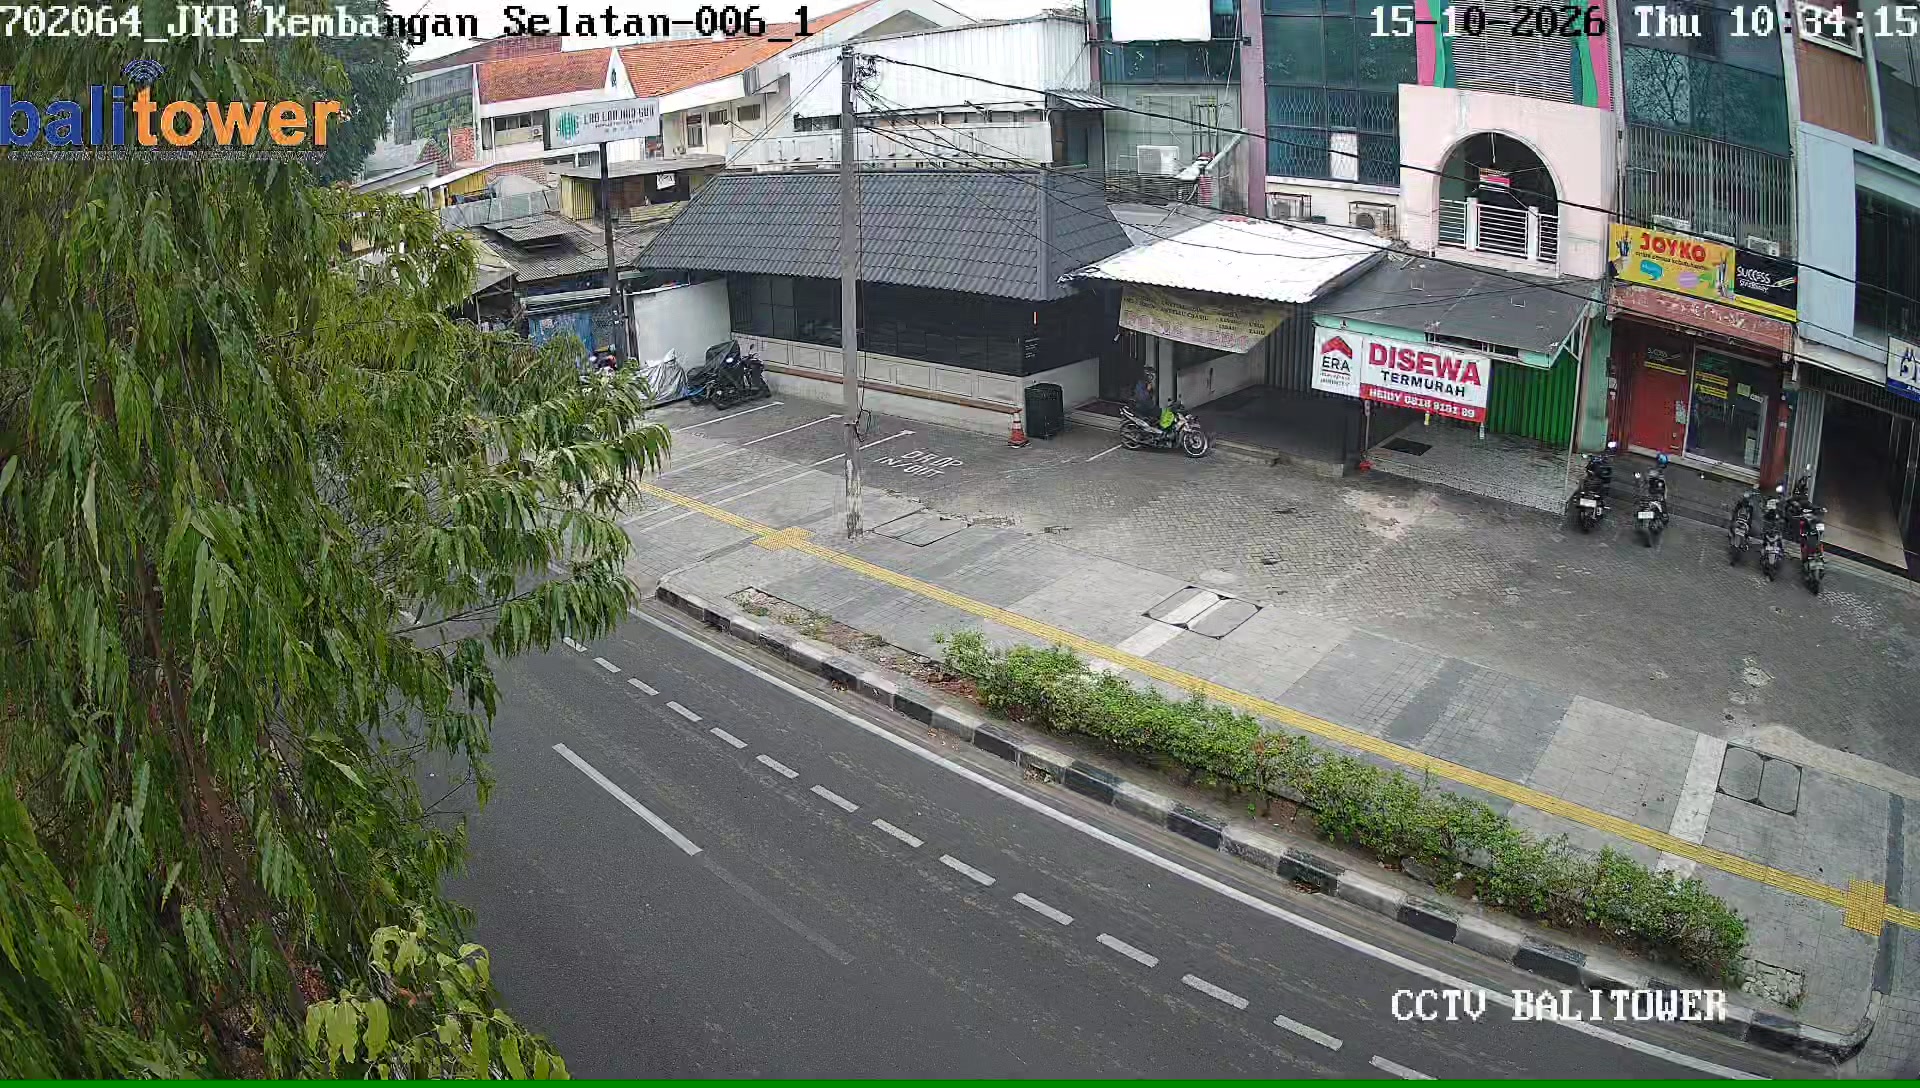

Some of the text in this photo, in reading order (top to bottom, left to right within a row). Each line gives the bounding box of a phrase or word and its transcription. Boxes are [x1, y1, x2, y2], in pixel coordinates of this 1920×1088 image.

[1640, 232, 1706, 263] JOYKO
[1736, 265, 1771, 285] SUCCESS
[1322, 355, 1351, 373] ERA
[1368, 342, 1481, 387] DISEWA
[1380, 370, 1465, 398] TERMURAH
